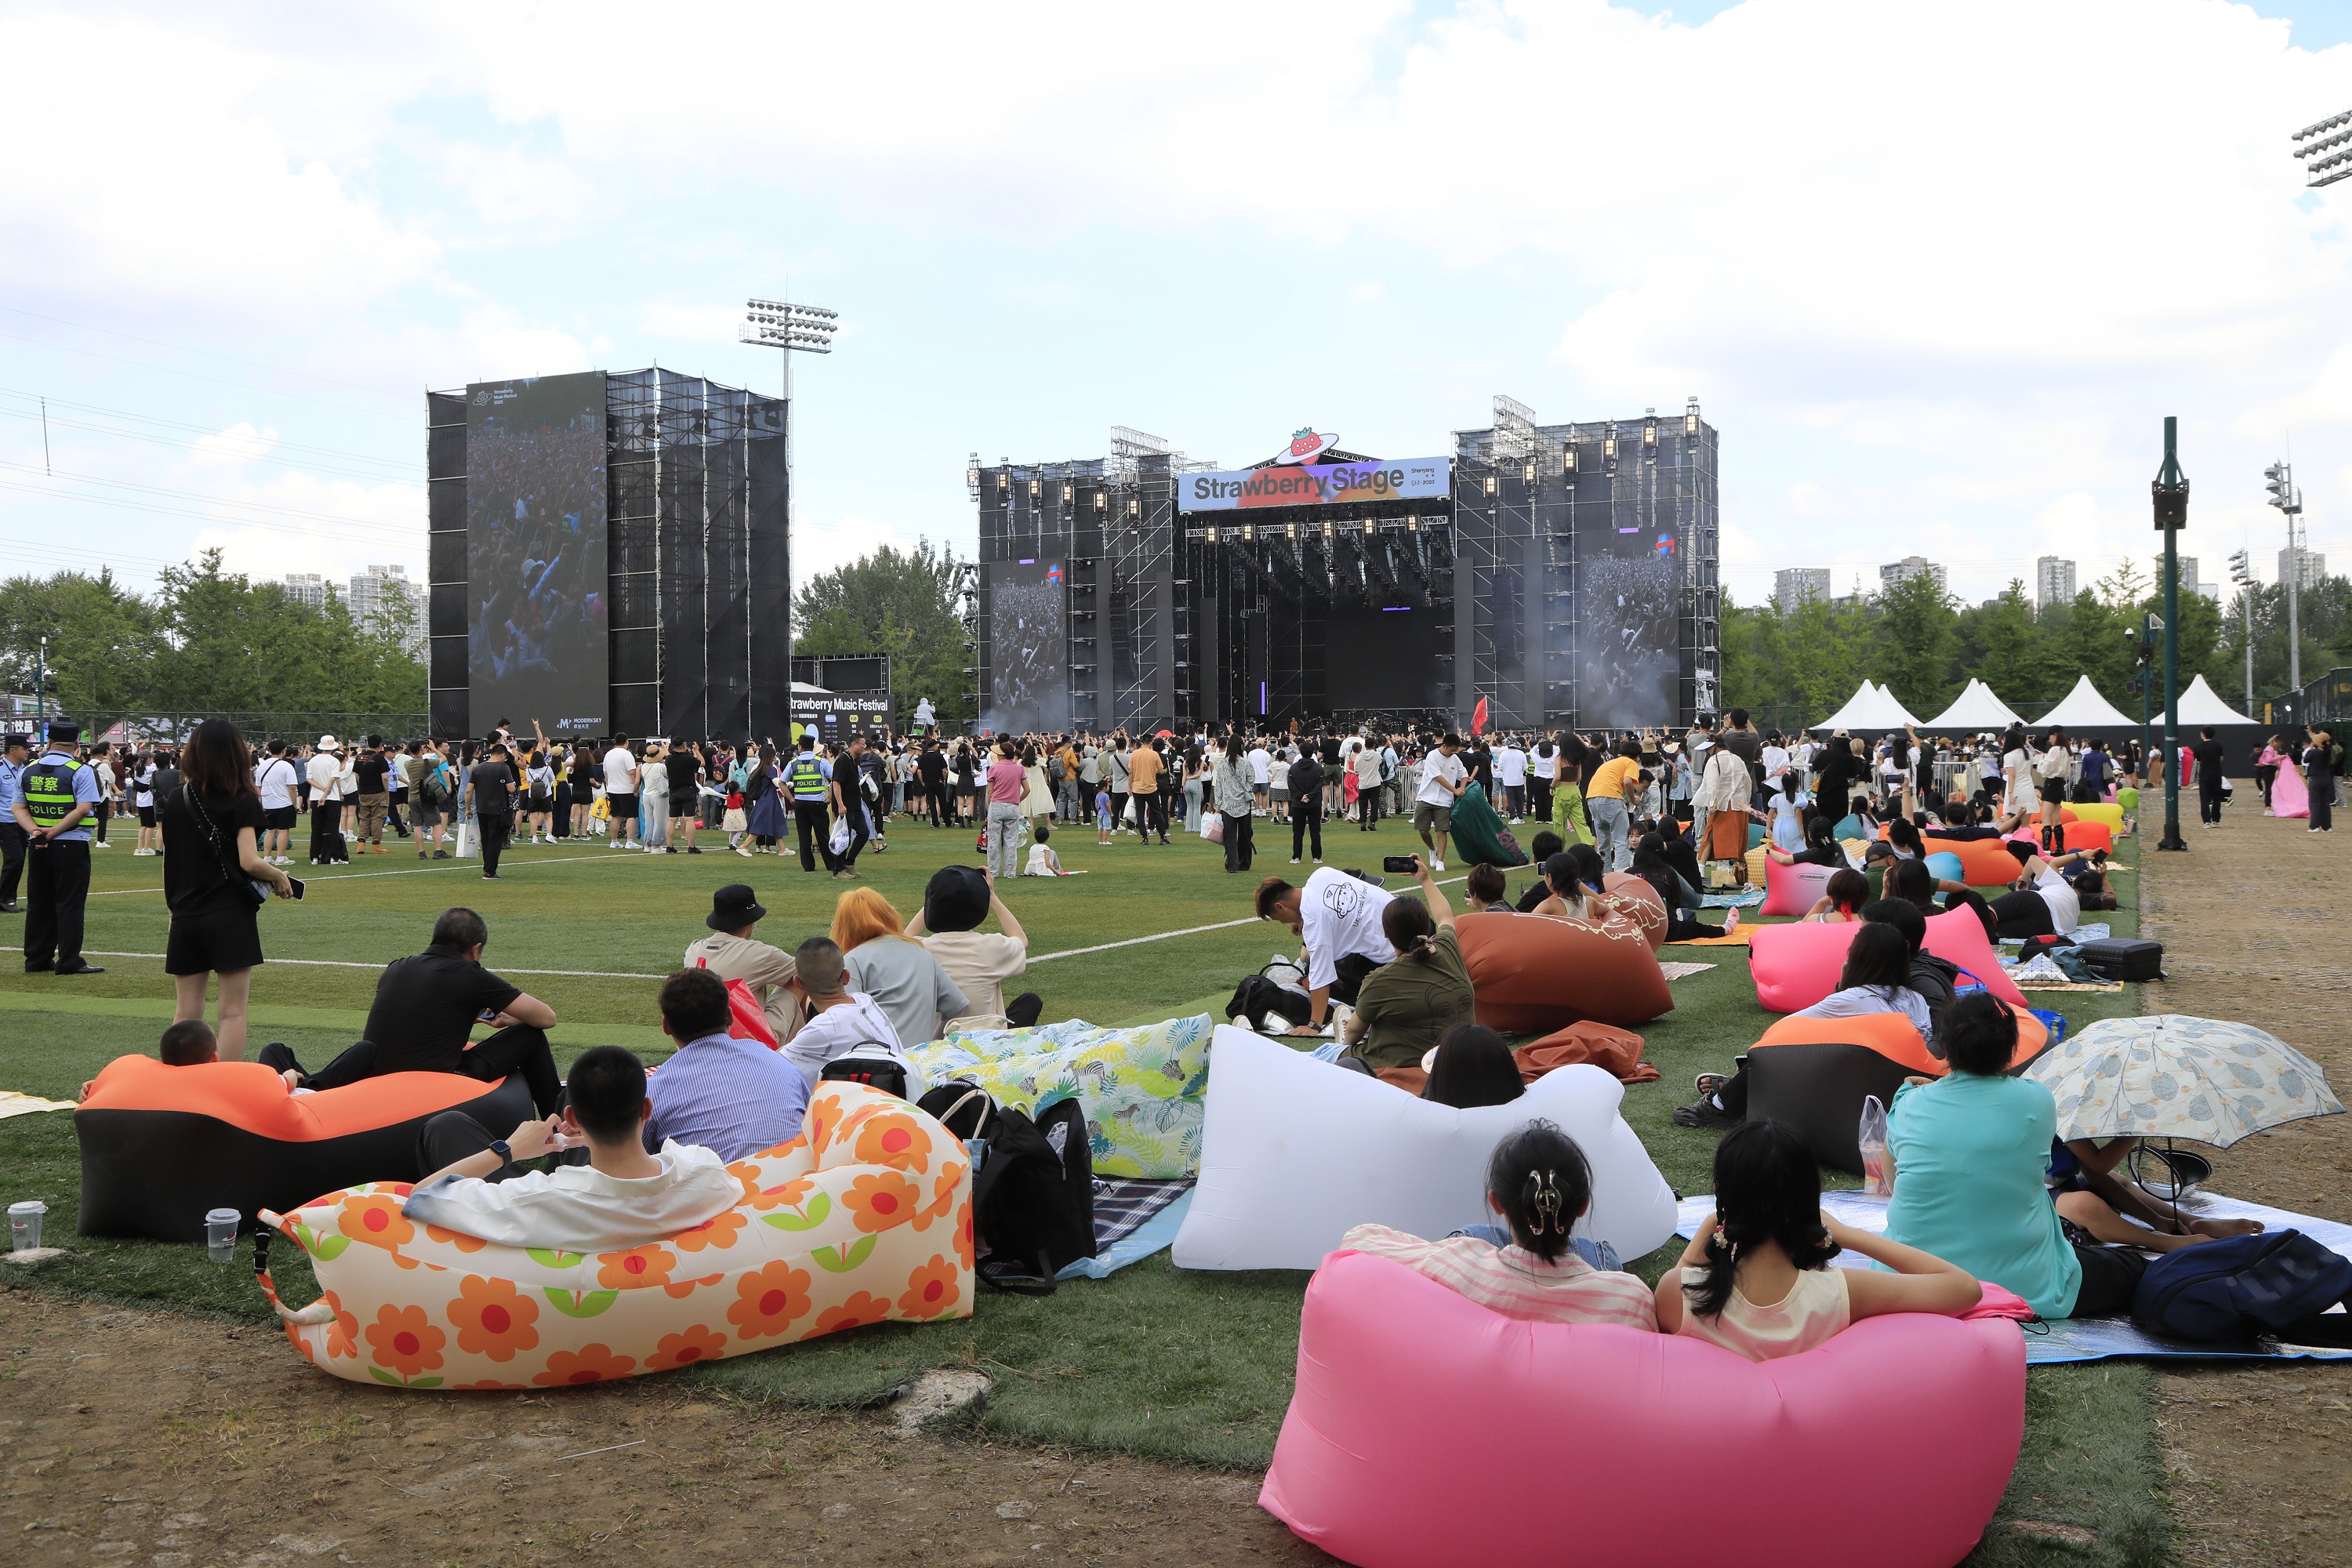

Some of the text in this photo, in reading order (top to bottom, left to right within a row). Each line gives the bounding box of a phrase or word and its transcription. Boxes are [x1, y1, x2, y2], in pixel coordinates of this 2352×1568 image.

[1194, 467, 1404, 499] Strawberry Stage
[790, 697, 888, 713] trawberry Music Festival
[797, 764, 815, 772] 警察
[30, 775, 59, 792] 警察
[29, 804, 65, 815] POLICE
